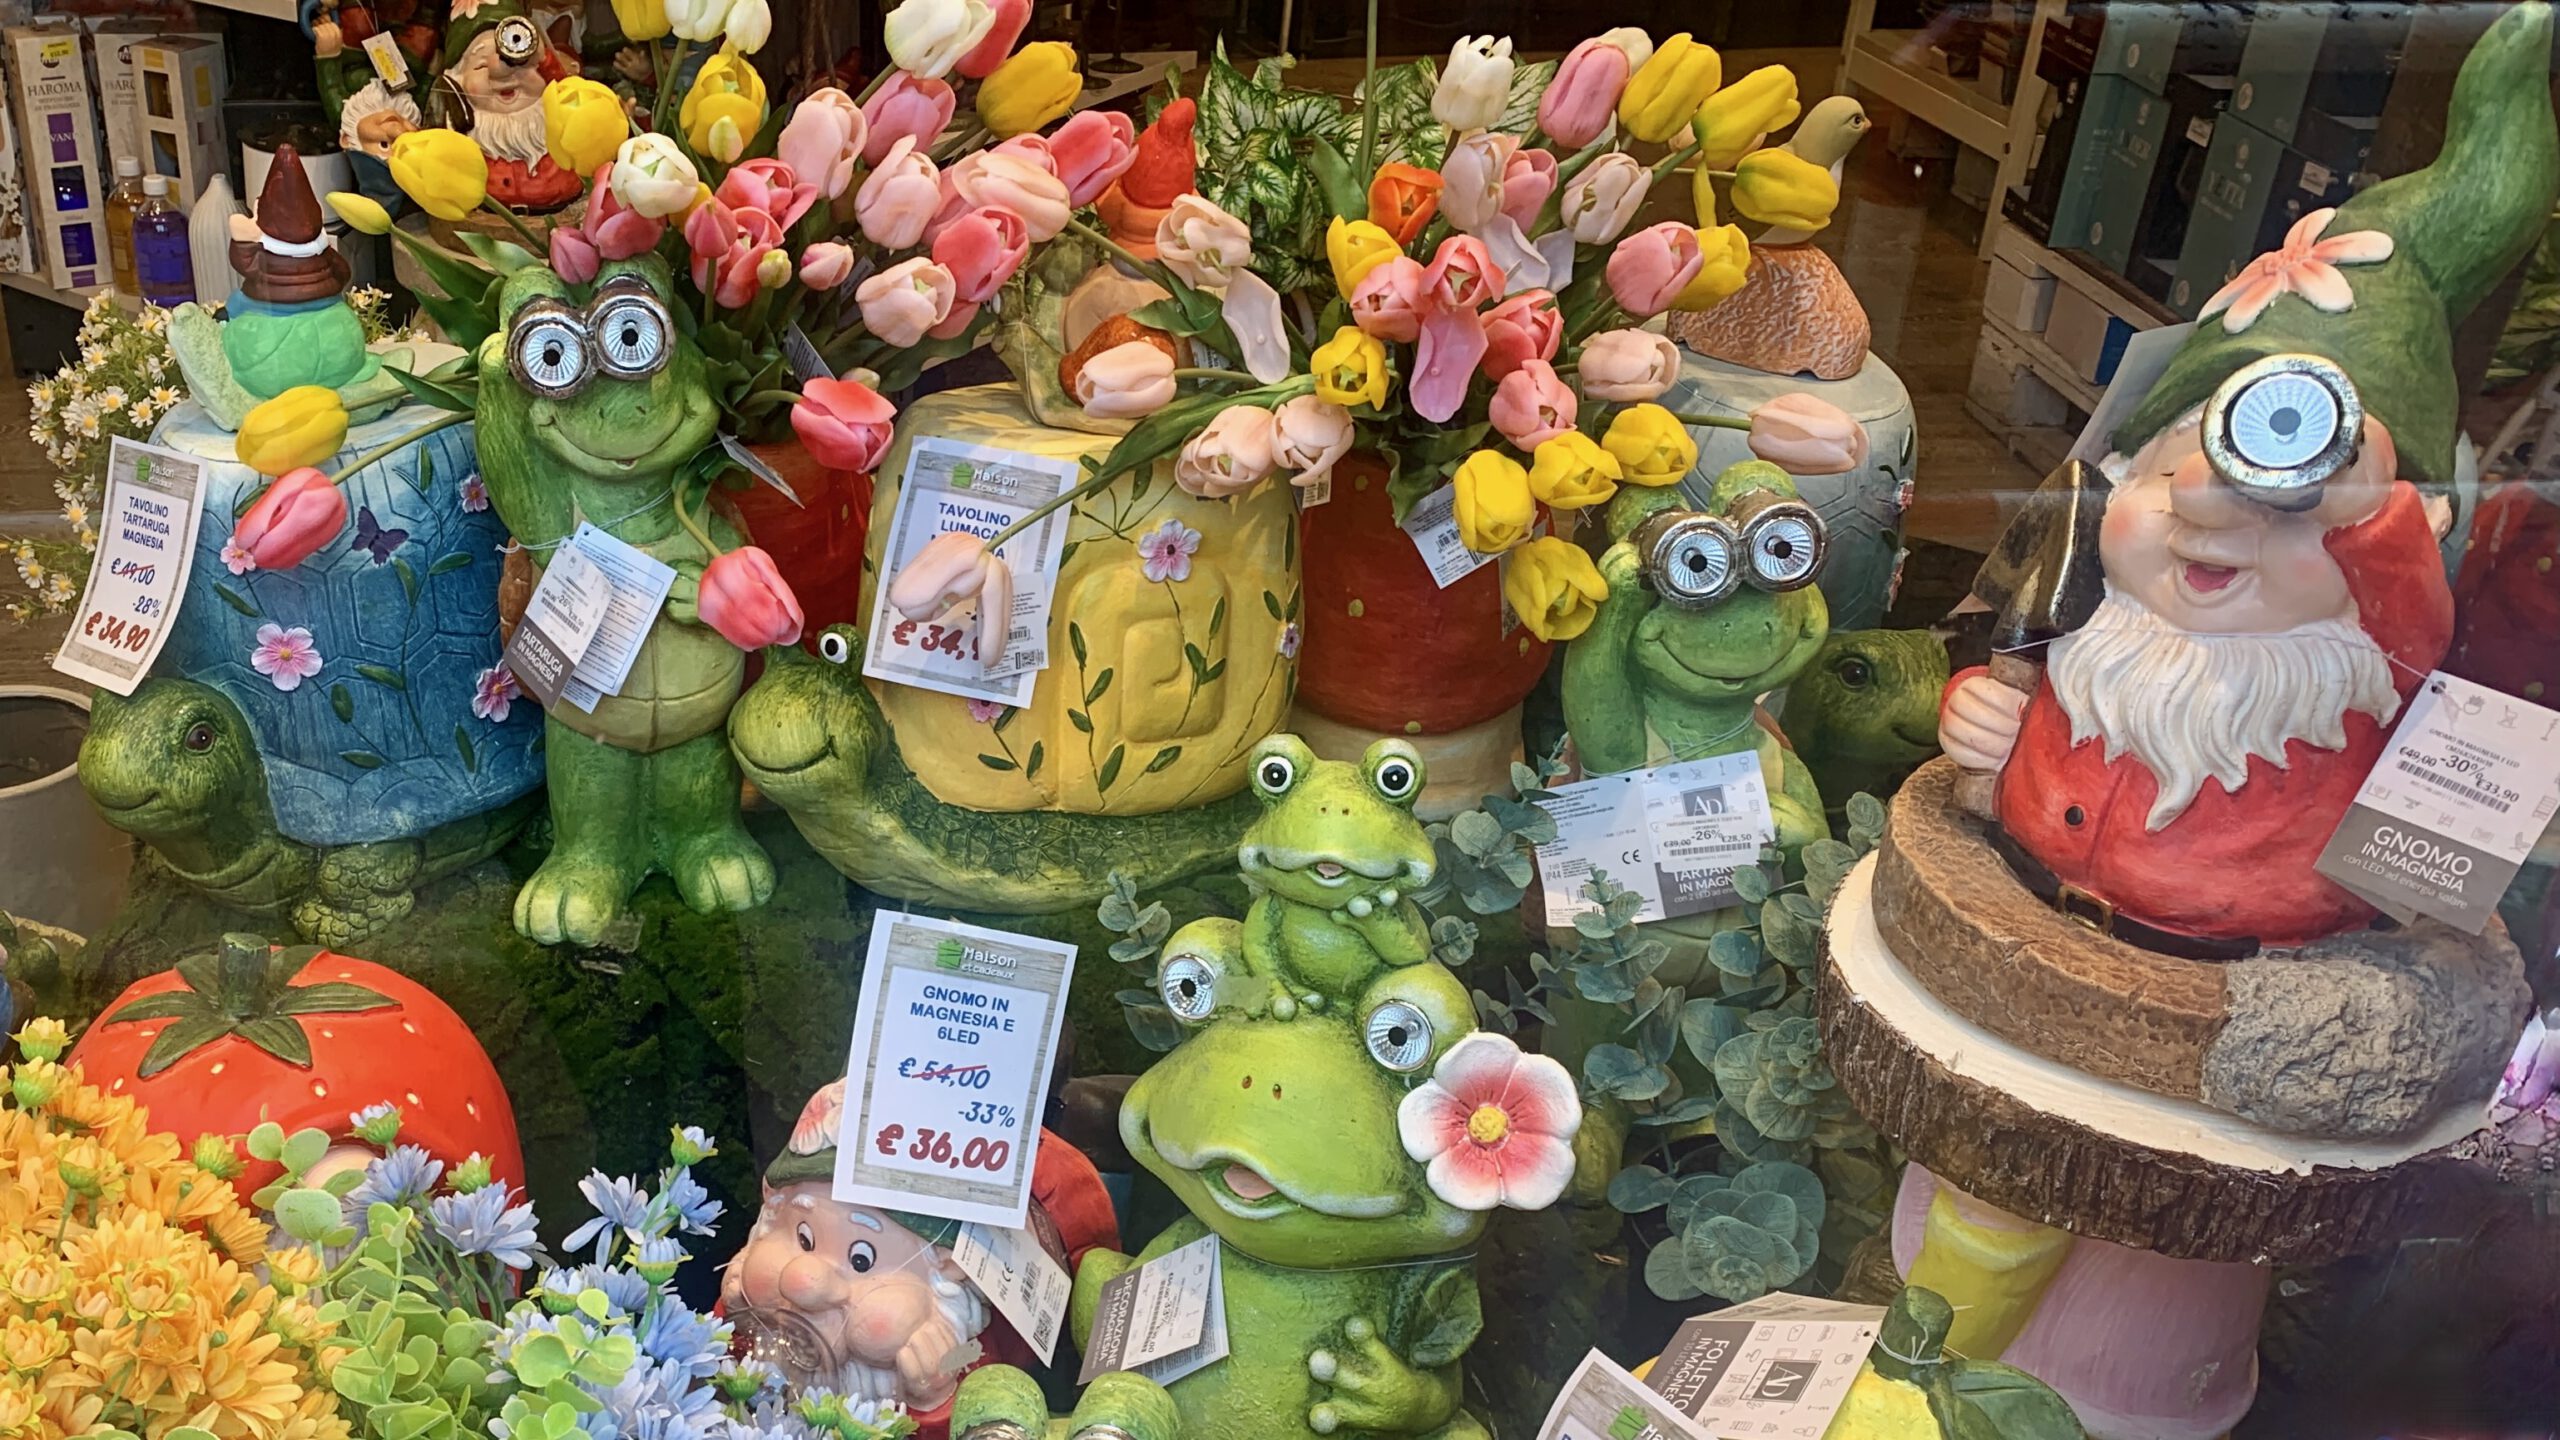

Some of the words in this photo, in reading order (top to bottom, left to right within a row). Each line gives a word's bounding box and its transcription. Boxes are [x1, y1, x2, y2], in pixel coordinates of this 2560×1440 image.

[27, 81, 82, 97] HAROMA
[974, 468, 1018, 488] Maison
[129, 496, 169, 518] TAVOLINO
[939, 502, 1011, 526] TAVOLINO
[122, 511, 170, 536] TARTARUGA
[122, 528, 164, 551] MAGNESIA
[122, 561, 155, 585] 49,00
[133, 595, 161, 618] -28%
[85, 611, 103, 636] €
[98, 615, 151, 652] 34,90
[892, 620, 917, 646] €
[517, 640, 526, 653] IN
[524, 647, 555, 684] MAGNESIA
[521, 626, 563, 677] TARTARUGA
[2440, 755, 2485, 780] -30%
[1691, 829, 1723, 841] -26%
[2374, 826, 2473, 876] GNOMO
[2342, 854, 2361, 866] con
[2362, 859, 2385, 875] LED
[2361, 842, 2381, 858] IN
[2381, 850, 2464, 893] MAGNESIA
[1679, 883, 1692, 894] IN
[963, 946, 1017, 969] Maison
[923, 985, 987, 1008] GNOMO
[991, 997, 1010, 1013] IN
[910, 1002, 999, 1030] MAGNESIA
[1003, 1019, 1015, 1032] E
[937, 1026, 980, 1045] 6LED
[898, 1057, 917, 1078] €
[920, 1060, 991, 1089] 54,00
[958, 1101, 1016, 1128] -33%
[875, 1123, 904, 1156] €
[909, 1128, 1010, 1172] 36,00
[1098, 1302, 1119, 1362] MAGNESIA
[1106, 1274, 1135, 1368] DECORAZIONE
[1695, 1337, 1713, 1350] IN
[1673, 1340, 1730, 1411] FOLLETTO
[1762, 1364, 1803, 1397] AD
